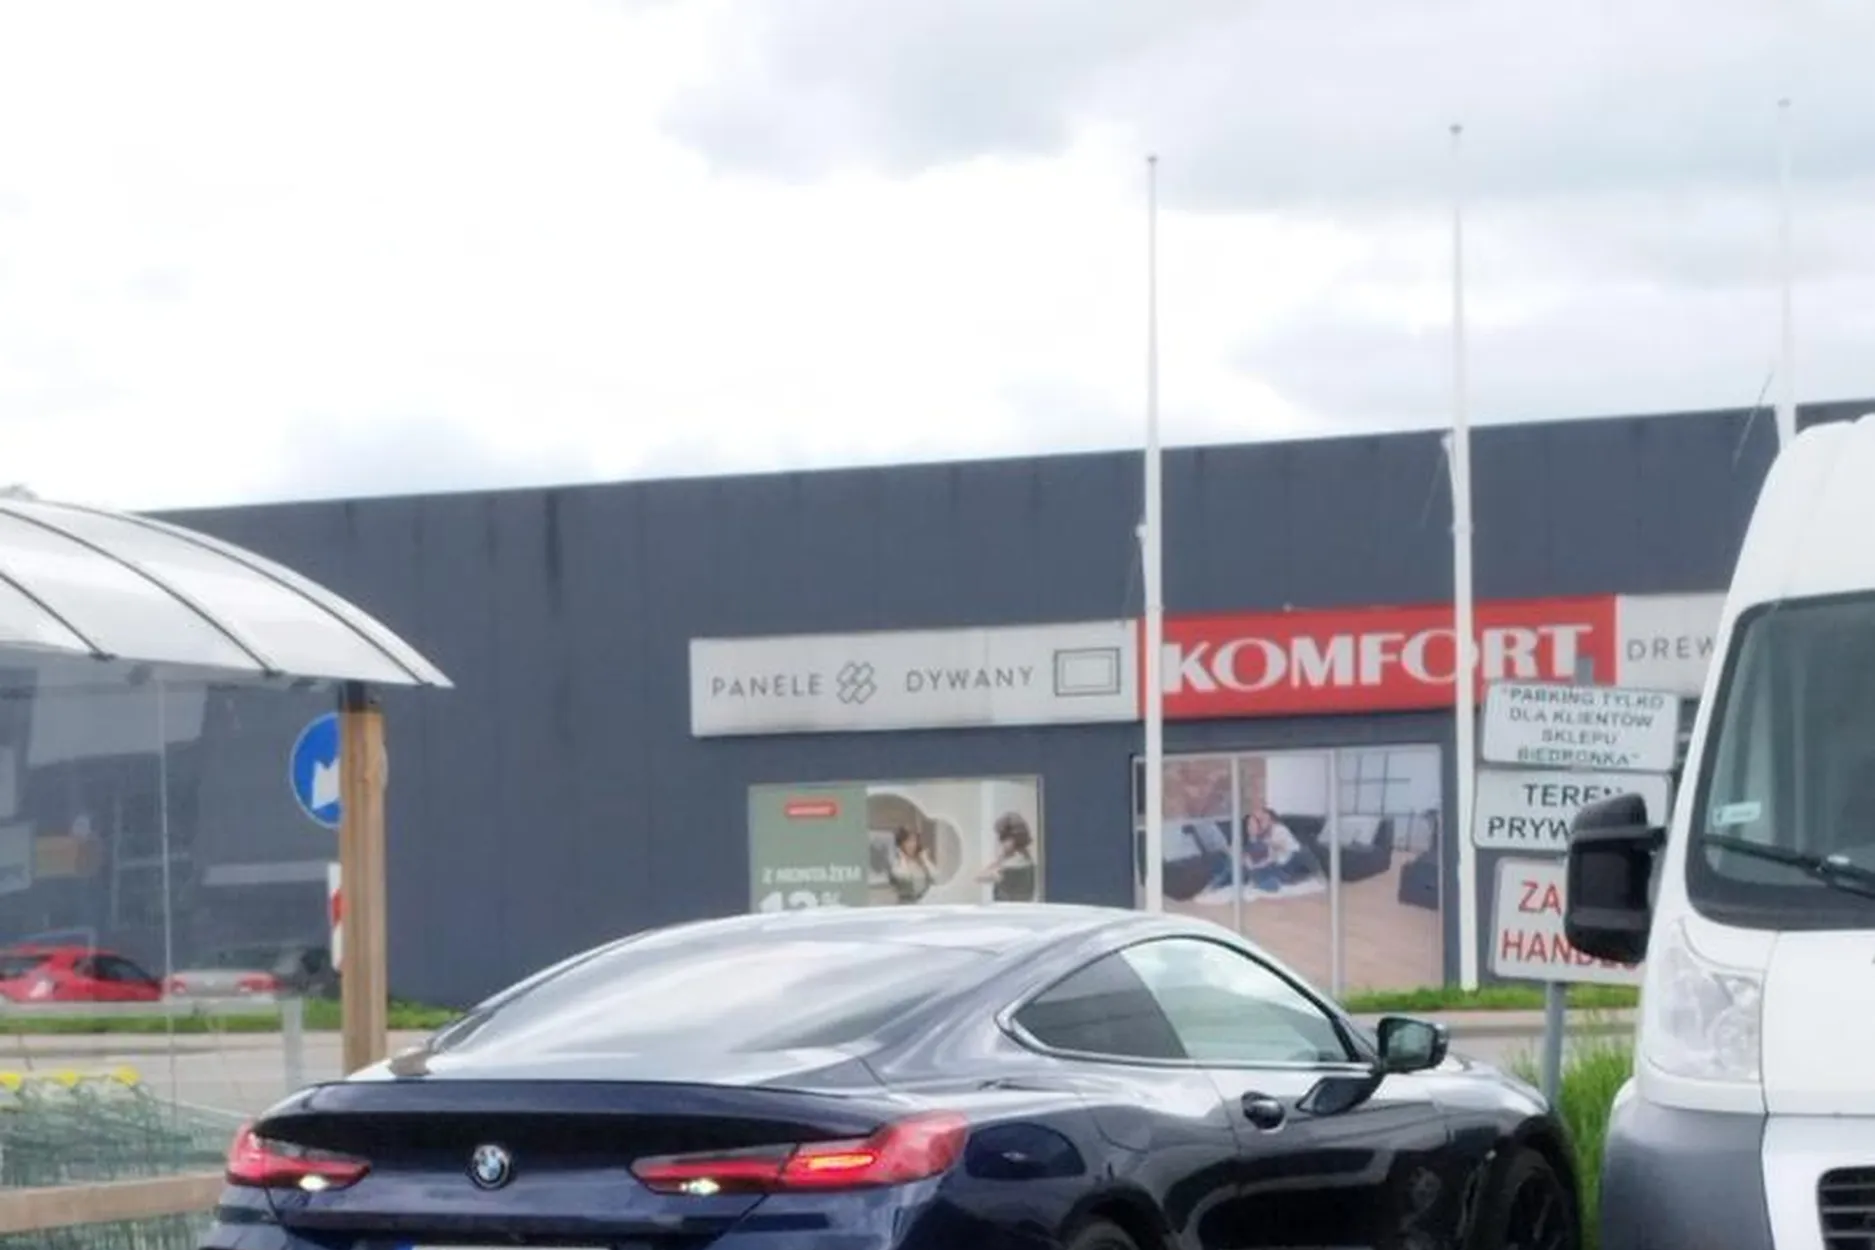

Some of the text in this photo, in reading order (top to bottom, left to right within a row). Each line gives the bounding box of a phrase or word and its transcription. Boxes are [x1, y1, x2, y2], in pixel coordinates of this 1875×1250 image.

[1161, 623, 1593, 693] KOMFORT
[1626, 634, 1715, 661] DREW
[711, 673, 823, 698] PANELE
[906, 666, 1035, 693] DYWANY
[1602, 691, 1665, 709] TYLKO
[1509, 706, 1548, 722] DLA
[1541, 729, 1617, 745] SKLEPU
[1522, 783, 1624, 808] TERE
[1486, 815, 1572, 840] PRYW
[1518, 879, 1562, 917] ZA
